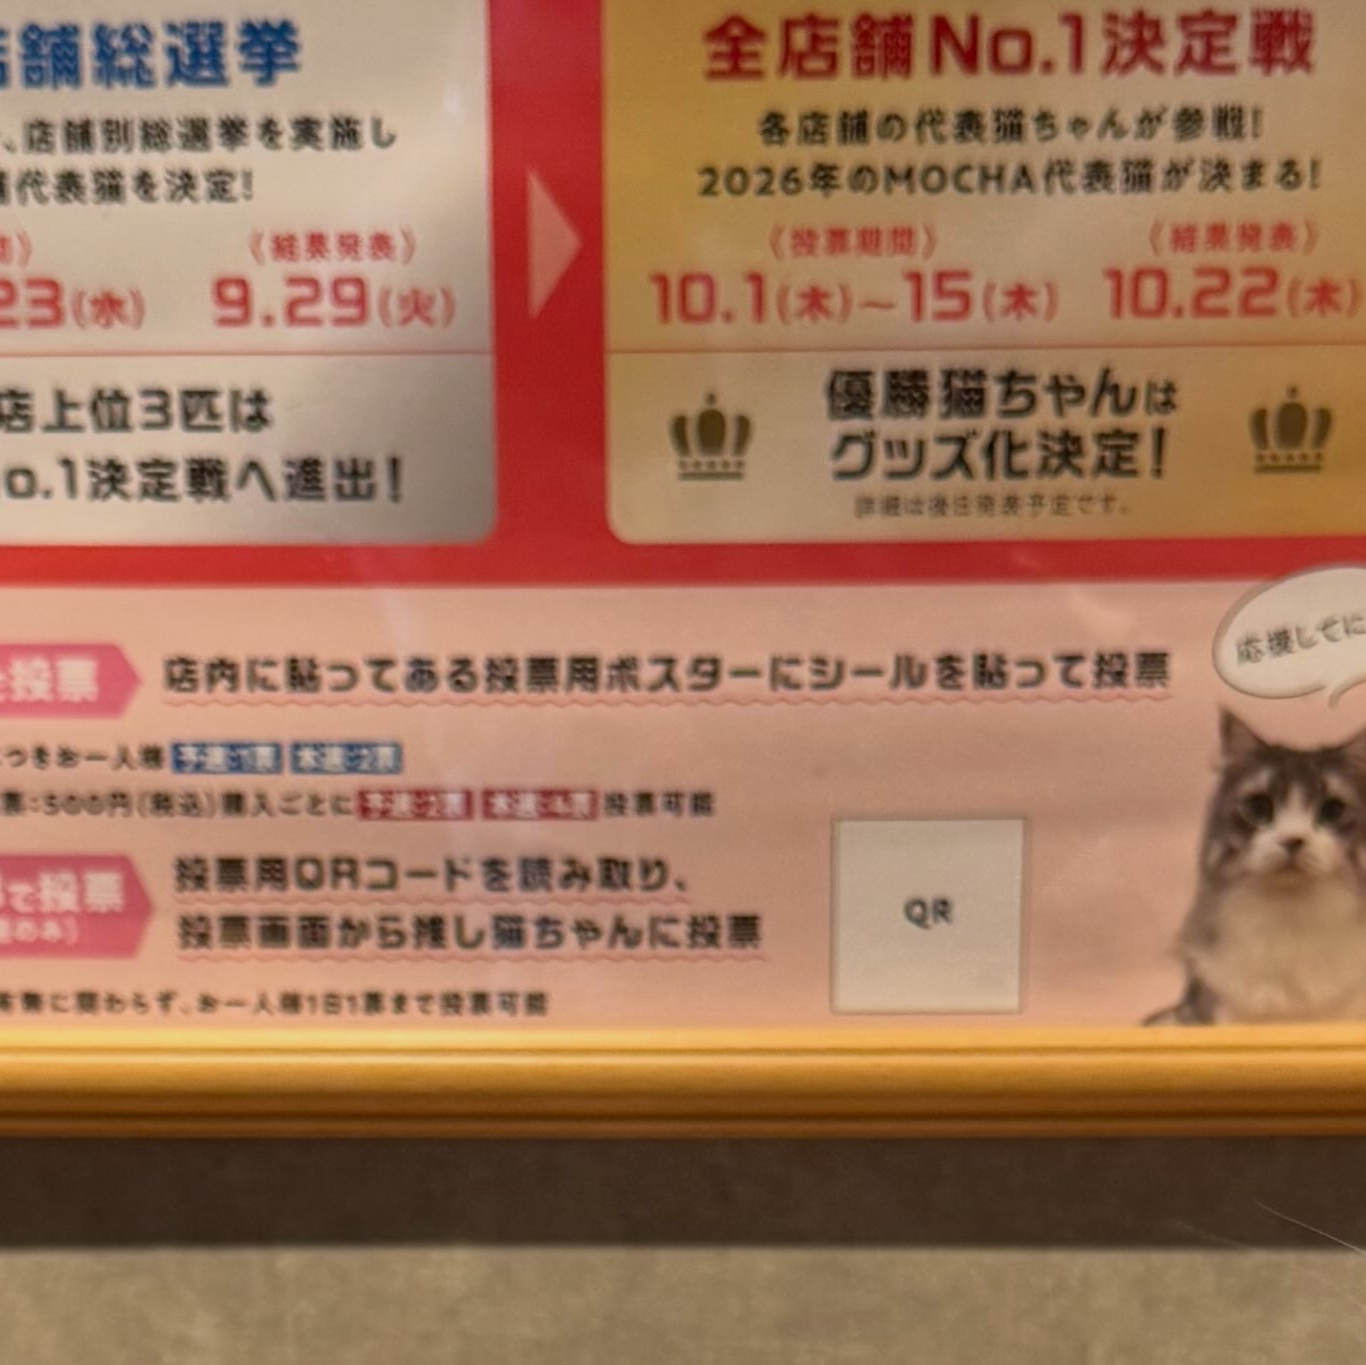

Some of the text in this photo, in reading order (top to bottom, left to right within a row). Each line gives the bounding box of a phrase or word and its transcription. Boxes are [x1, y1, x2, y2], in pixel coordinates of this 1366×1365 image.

[704, 9, 1315, 81] 全店舗No.1決定戦
[757, 106, 1263, 146] 各店舗の代表猫ちゃんが参戦!
[696, 158, 1321, 197] 2026年のMOCHA代表猫が決まる!
[826, 368, 1177, 420] 優勝猫ちゃんは
[830, 429, 1165, 483] グッズ化決定!
[162, 652, 1171, 695] 店内に貼ってある投票用ポスターにシールを貼って投票
[178, 913, 764, 951] 投票画面から推し猫ちゃんに投票
[904, 897, 952, 929] QR
